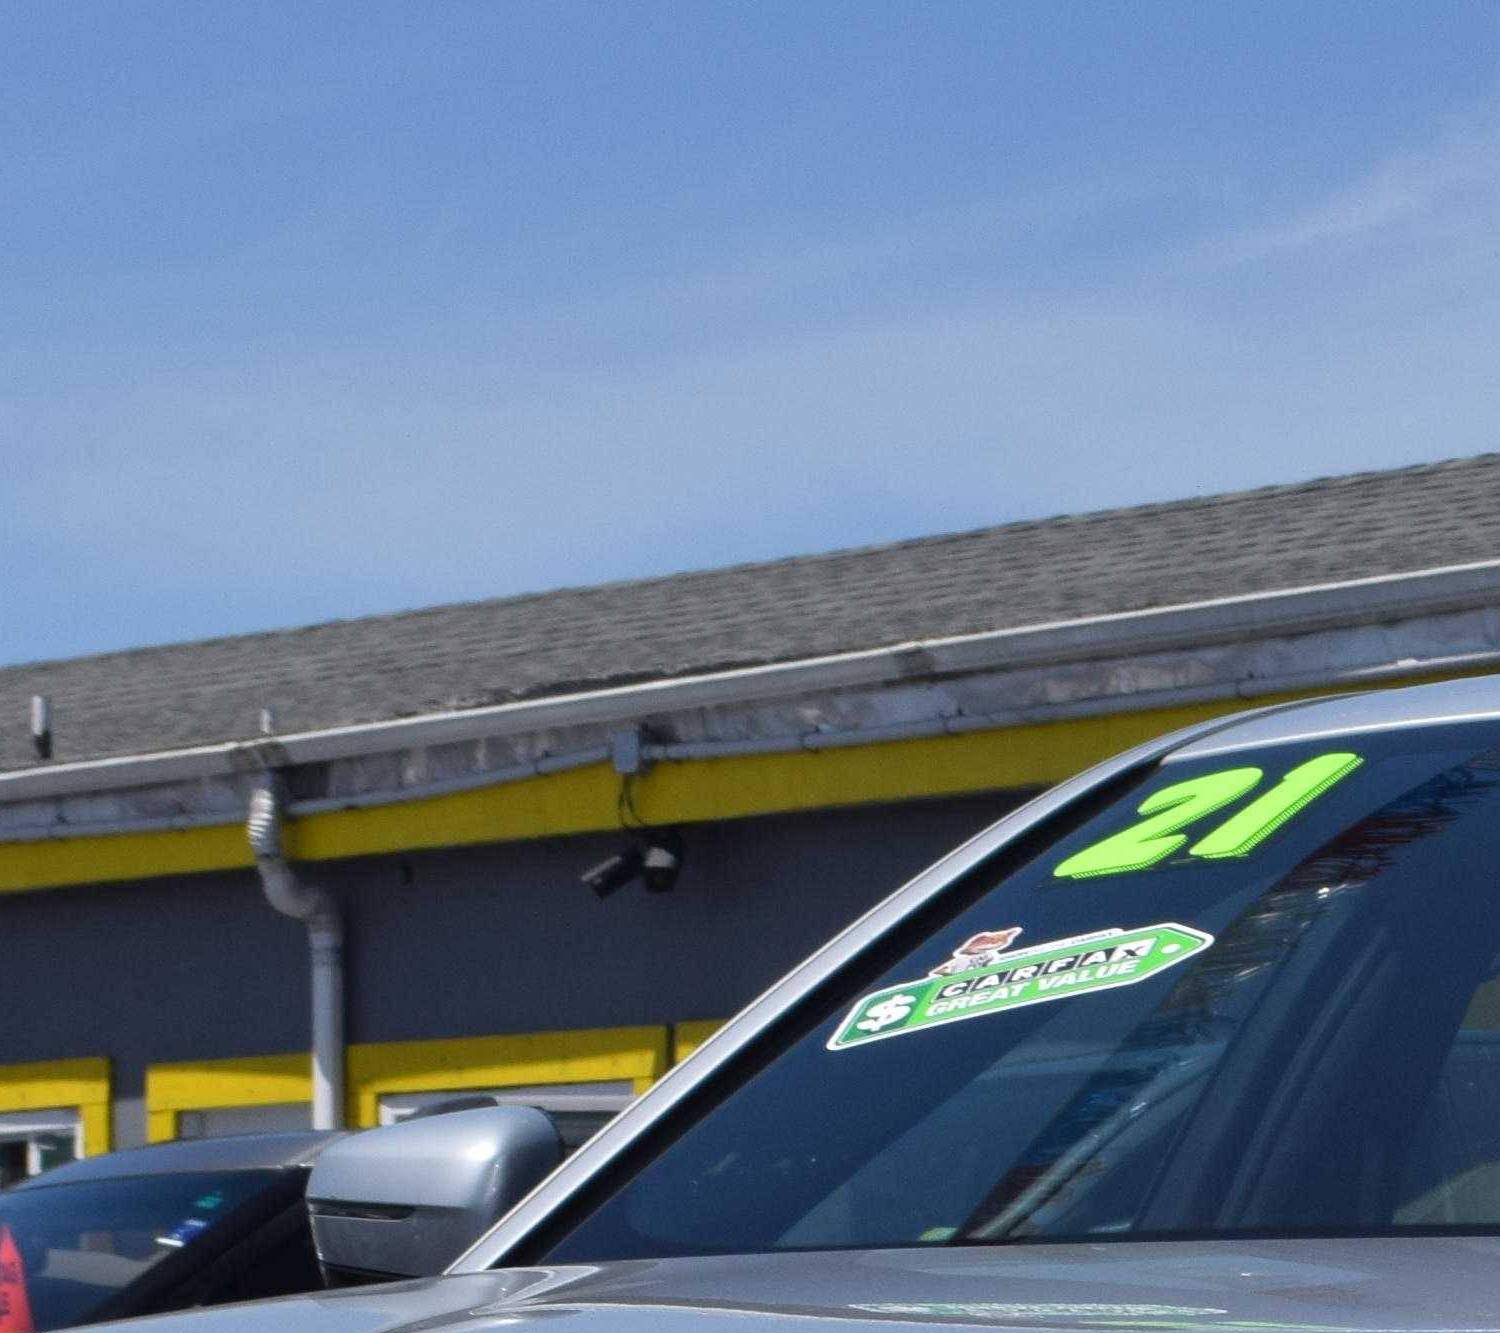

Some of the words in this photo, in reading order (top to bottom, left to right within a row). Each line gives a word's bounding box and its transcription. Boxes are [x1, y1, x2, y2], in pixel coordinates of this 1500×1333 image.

[1054, 752, 1364, 879] 21
[926, 982, 1031, 1017] GREAT
[1038, 959, 1142, 991] VALUE
[941, 941, 1148, 997] CARFAX
